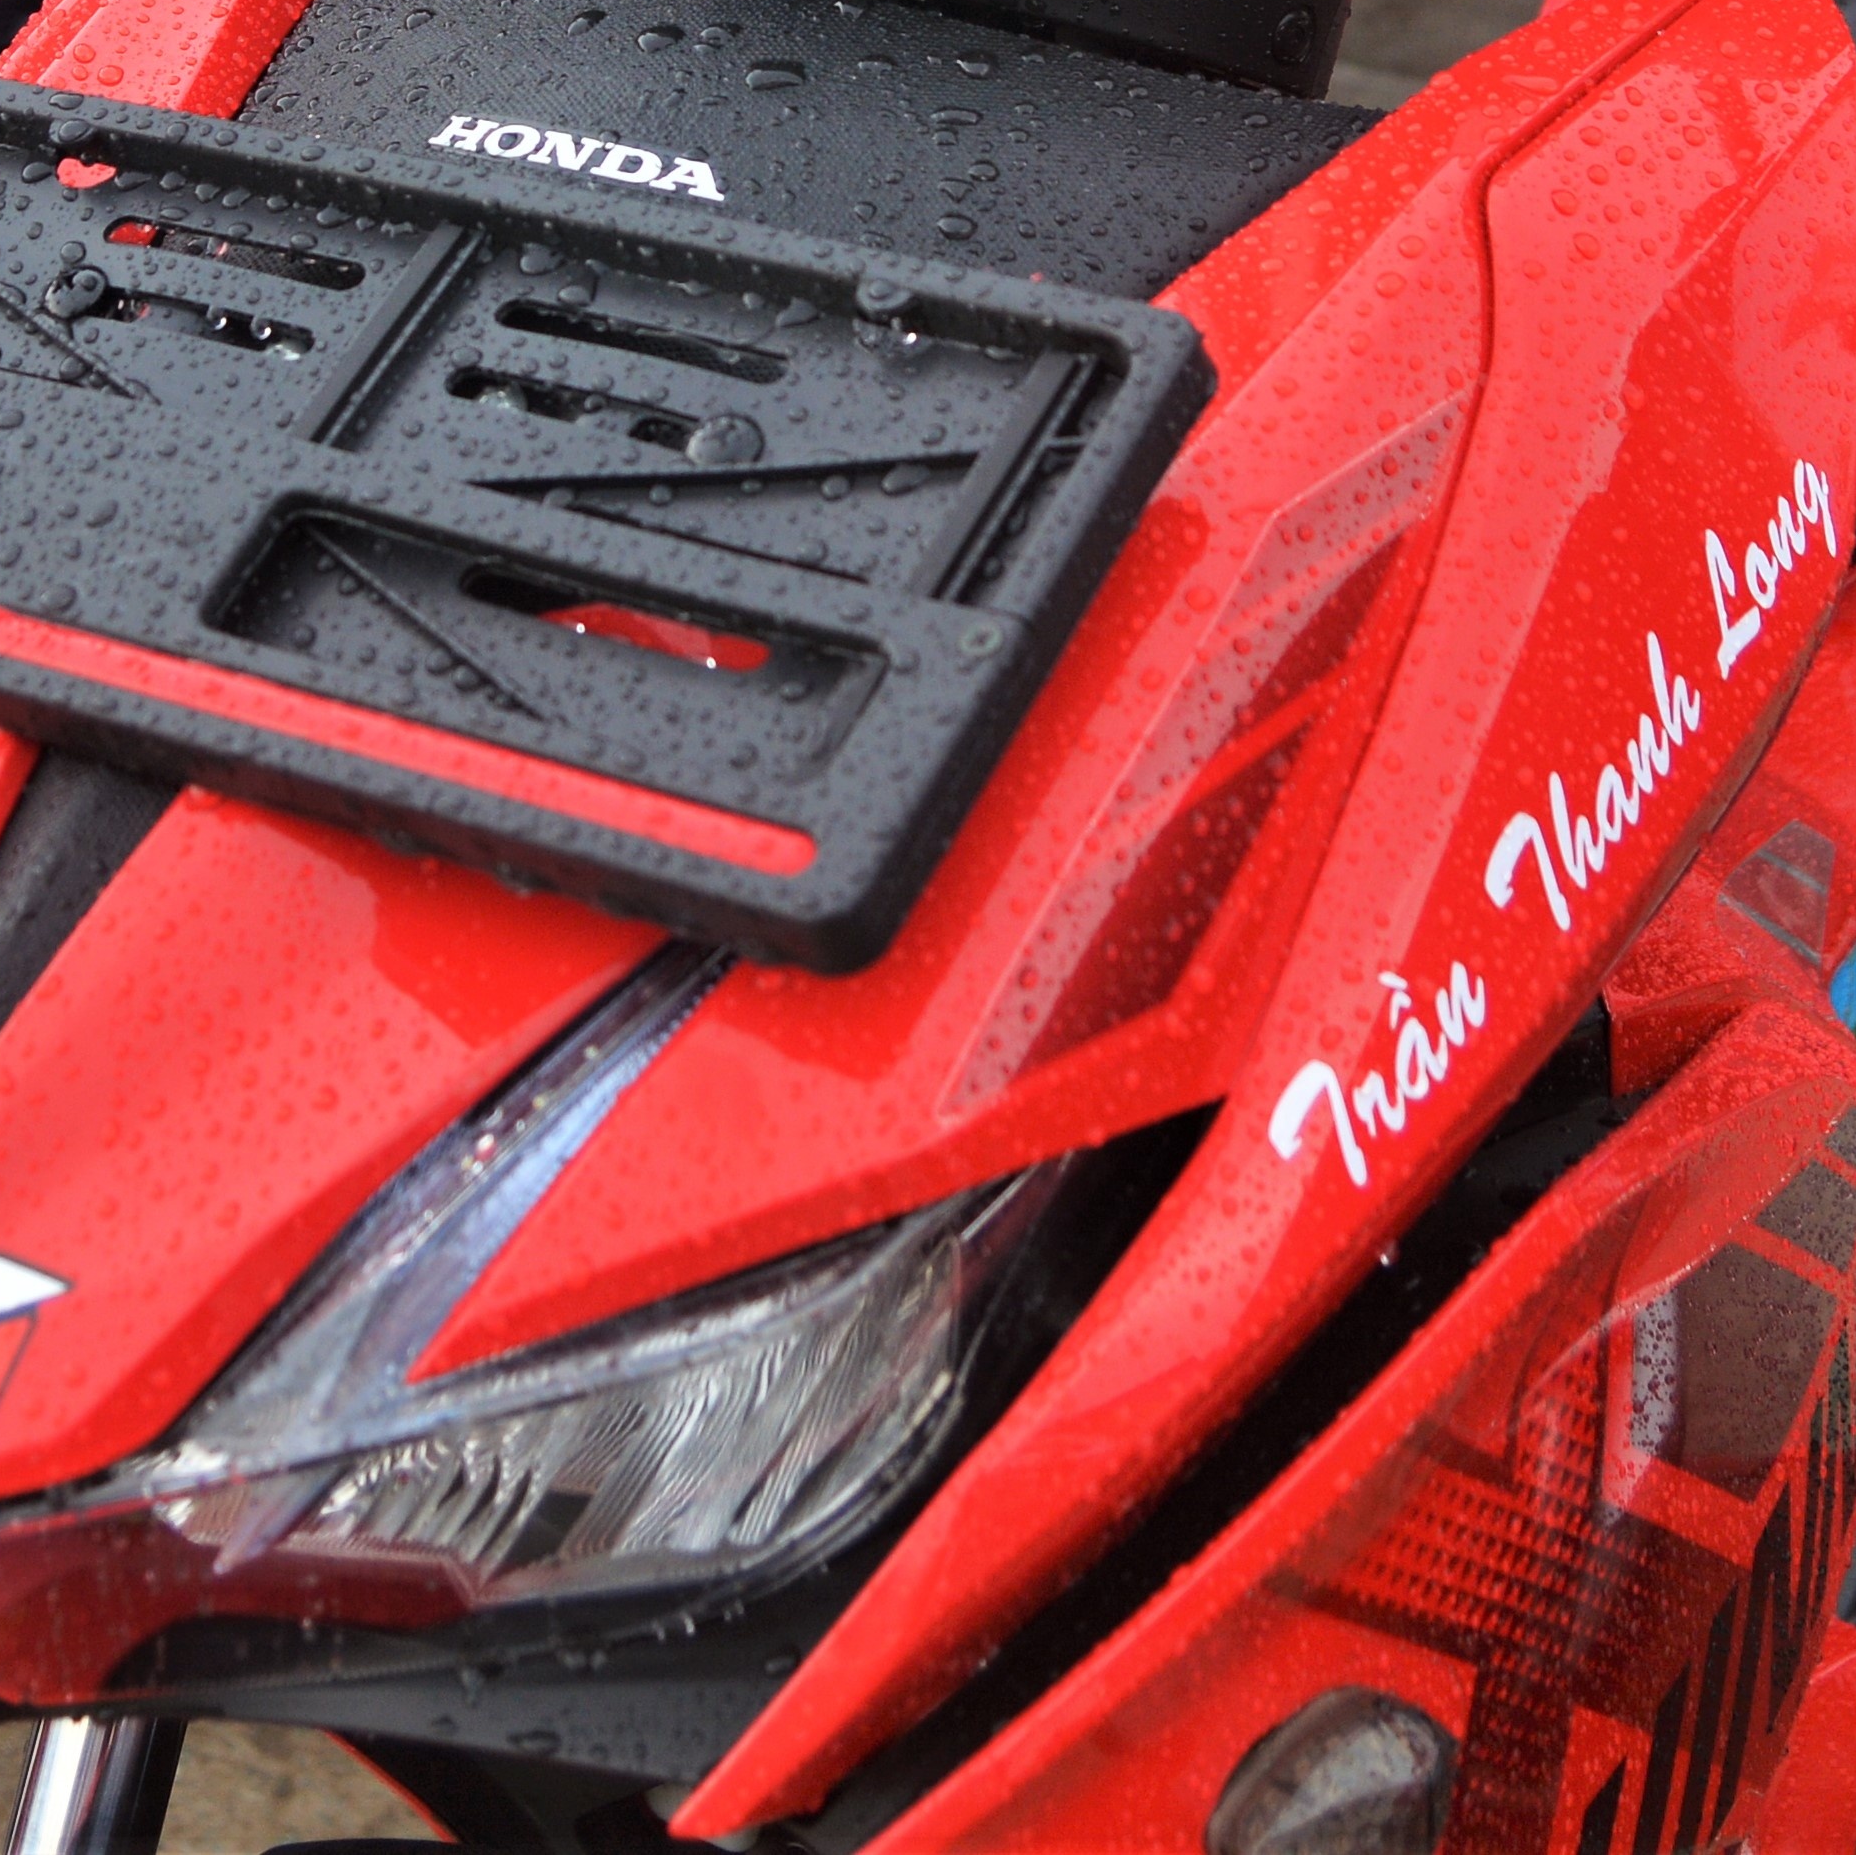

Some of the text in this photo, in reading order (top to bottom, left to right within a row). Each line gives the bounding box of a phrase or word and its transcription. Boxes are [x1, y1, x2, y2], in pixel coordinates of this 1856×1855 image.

[428, 115, 725, 203] HONDA
[1268, 458, 1838, 1187] Trần Thanh Long
